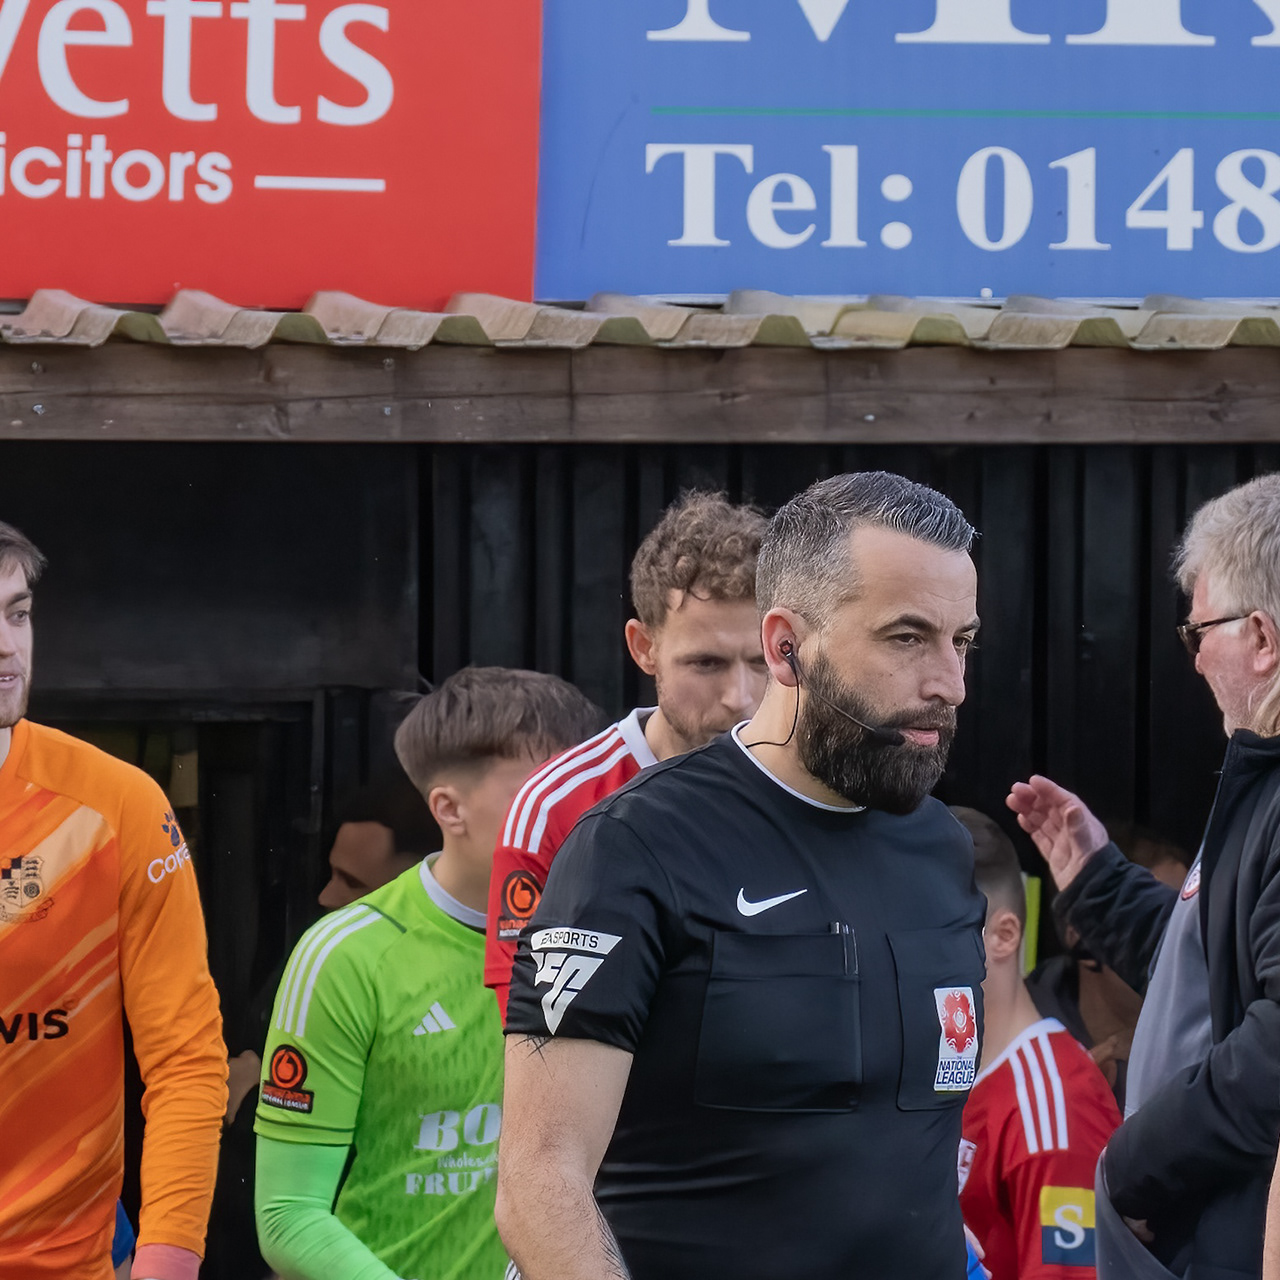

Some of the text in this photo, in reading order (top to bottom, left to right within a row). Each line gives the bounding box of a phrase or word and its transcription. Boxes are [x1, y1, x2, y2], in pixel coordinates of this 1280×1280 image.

[646, 144, 914, 249] Tel:
[936, 1070, 974, 1084] LEAGUE
[1054, 1204, 1085, 1249] S
